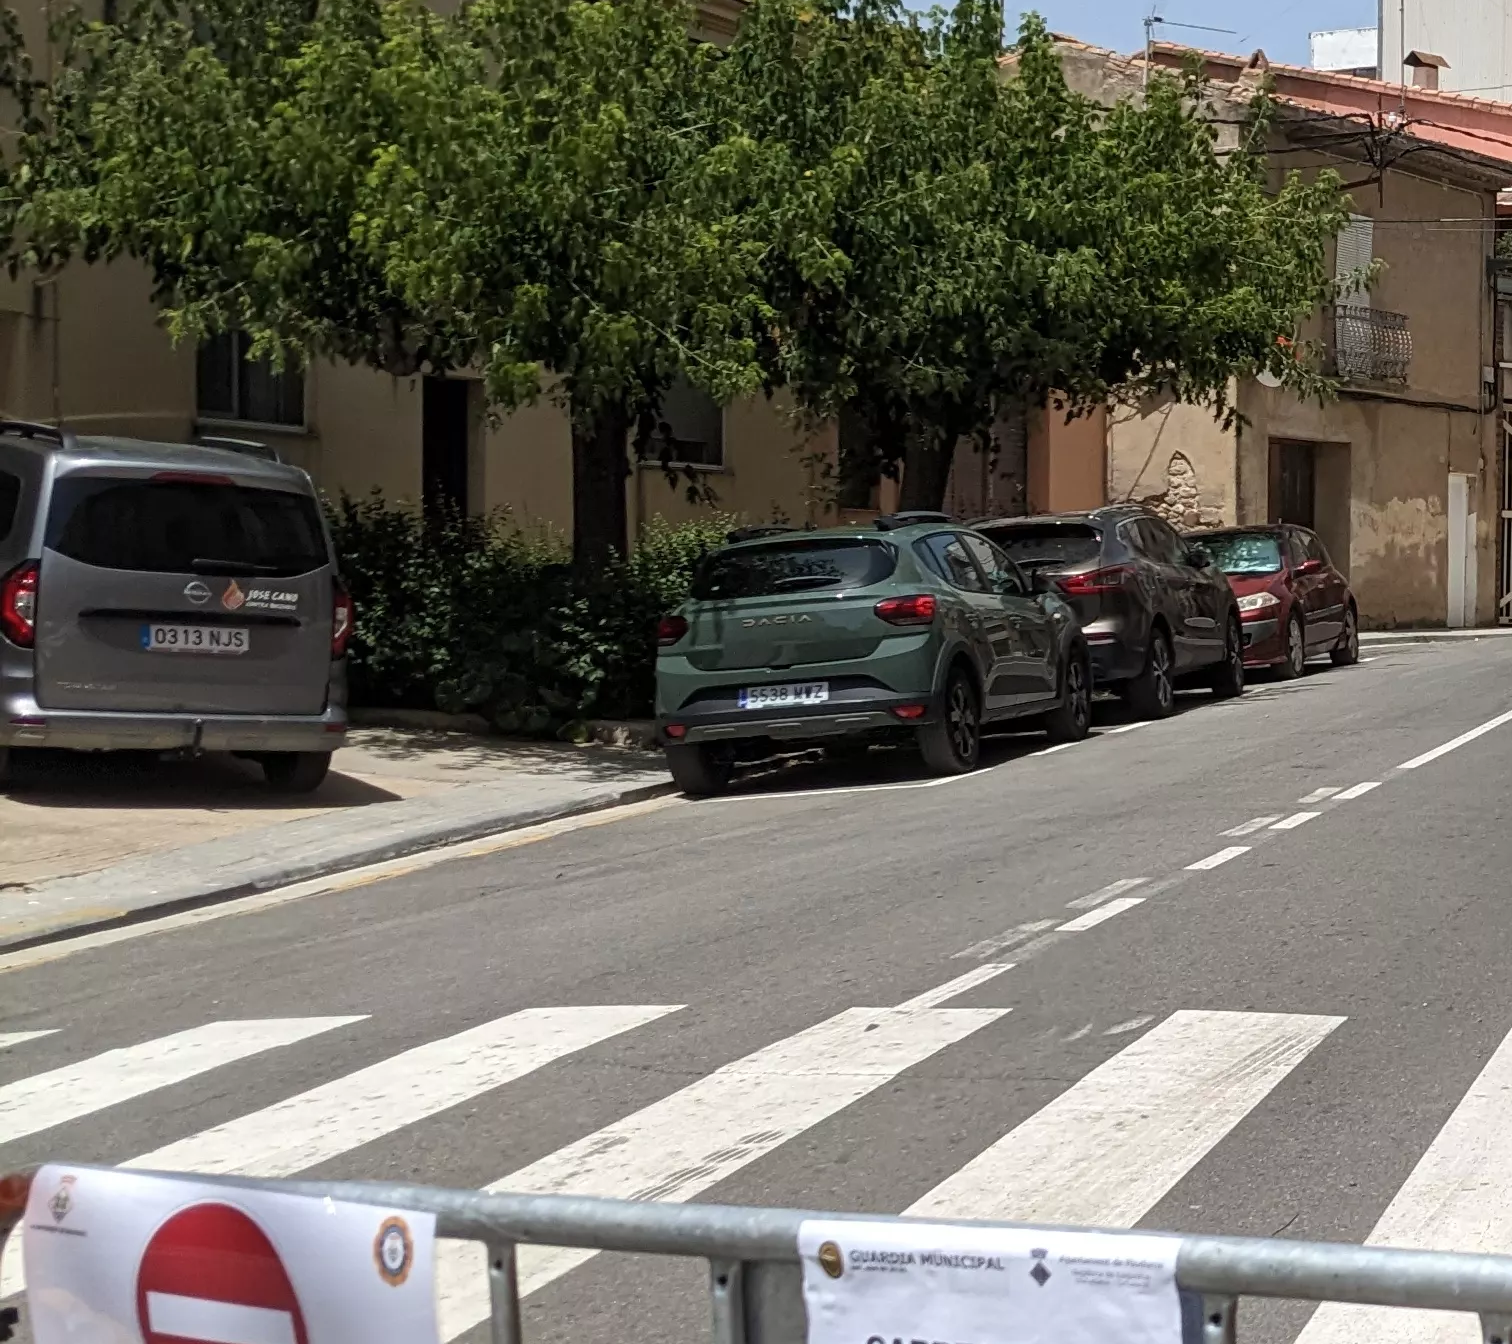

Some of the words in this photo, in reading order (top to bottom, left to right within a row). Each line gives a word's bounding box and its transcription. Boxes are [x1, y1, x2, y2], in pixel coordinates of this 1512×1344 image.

[742, 614, 812, 628] DACIA
[154, 628, 203, 646] 0313
[209, 630, 244, 648] NJS
[750, 687, 788, 703] 5538
[849, 1249, 915, 1265] GUARDIA
[921, 1252, 1005, 1271] MUNICIPAL
